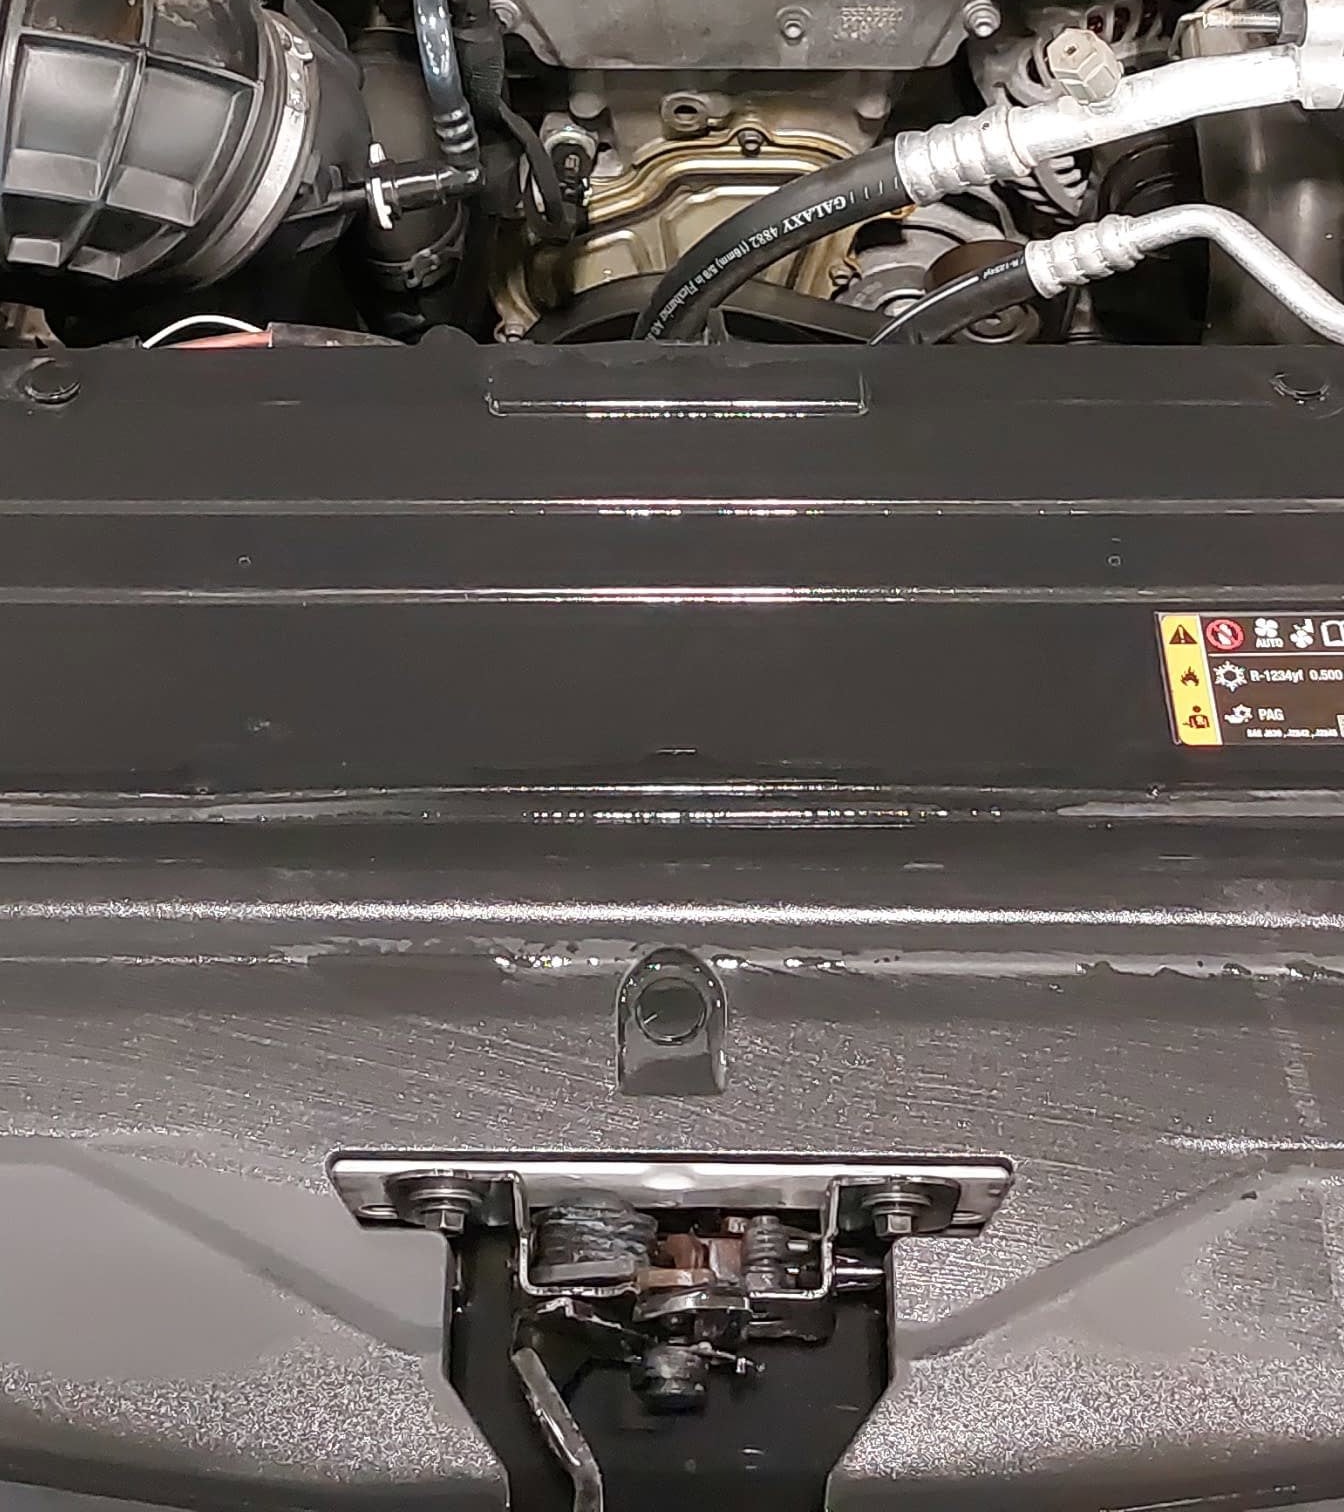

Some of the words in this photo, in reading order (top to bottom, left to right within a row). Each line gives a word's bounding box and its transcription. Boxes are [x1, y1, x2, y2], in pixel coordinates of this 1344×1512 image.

[780, 194, 848, 235] GALAXY
[749, 225, 778, 248] 4882
[1256, 638, 1284, 648] AUTO
[1249, 669, 1304, 683] R-1234yf
[1309, 669, 1343, 681] 0.500
[1258, 708, 1285, 721] PAG
